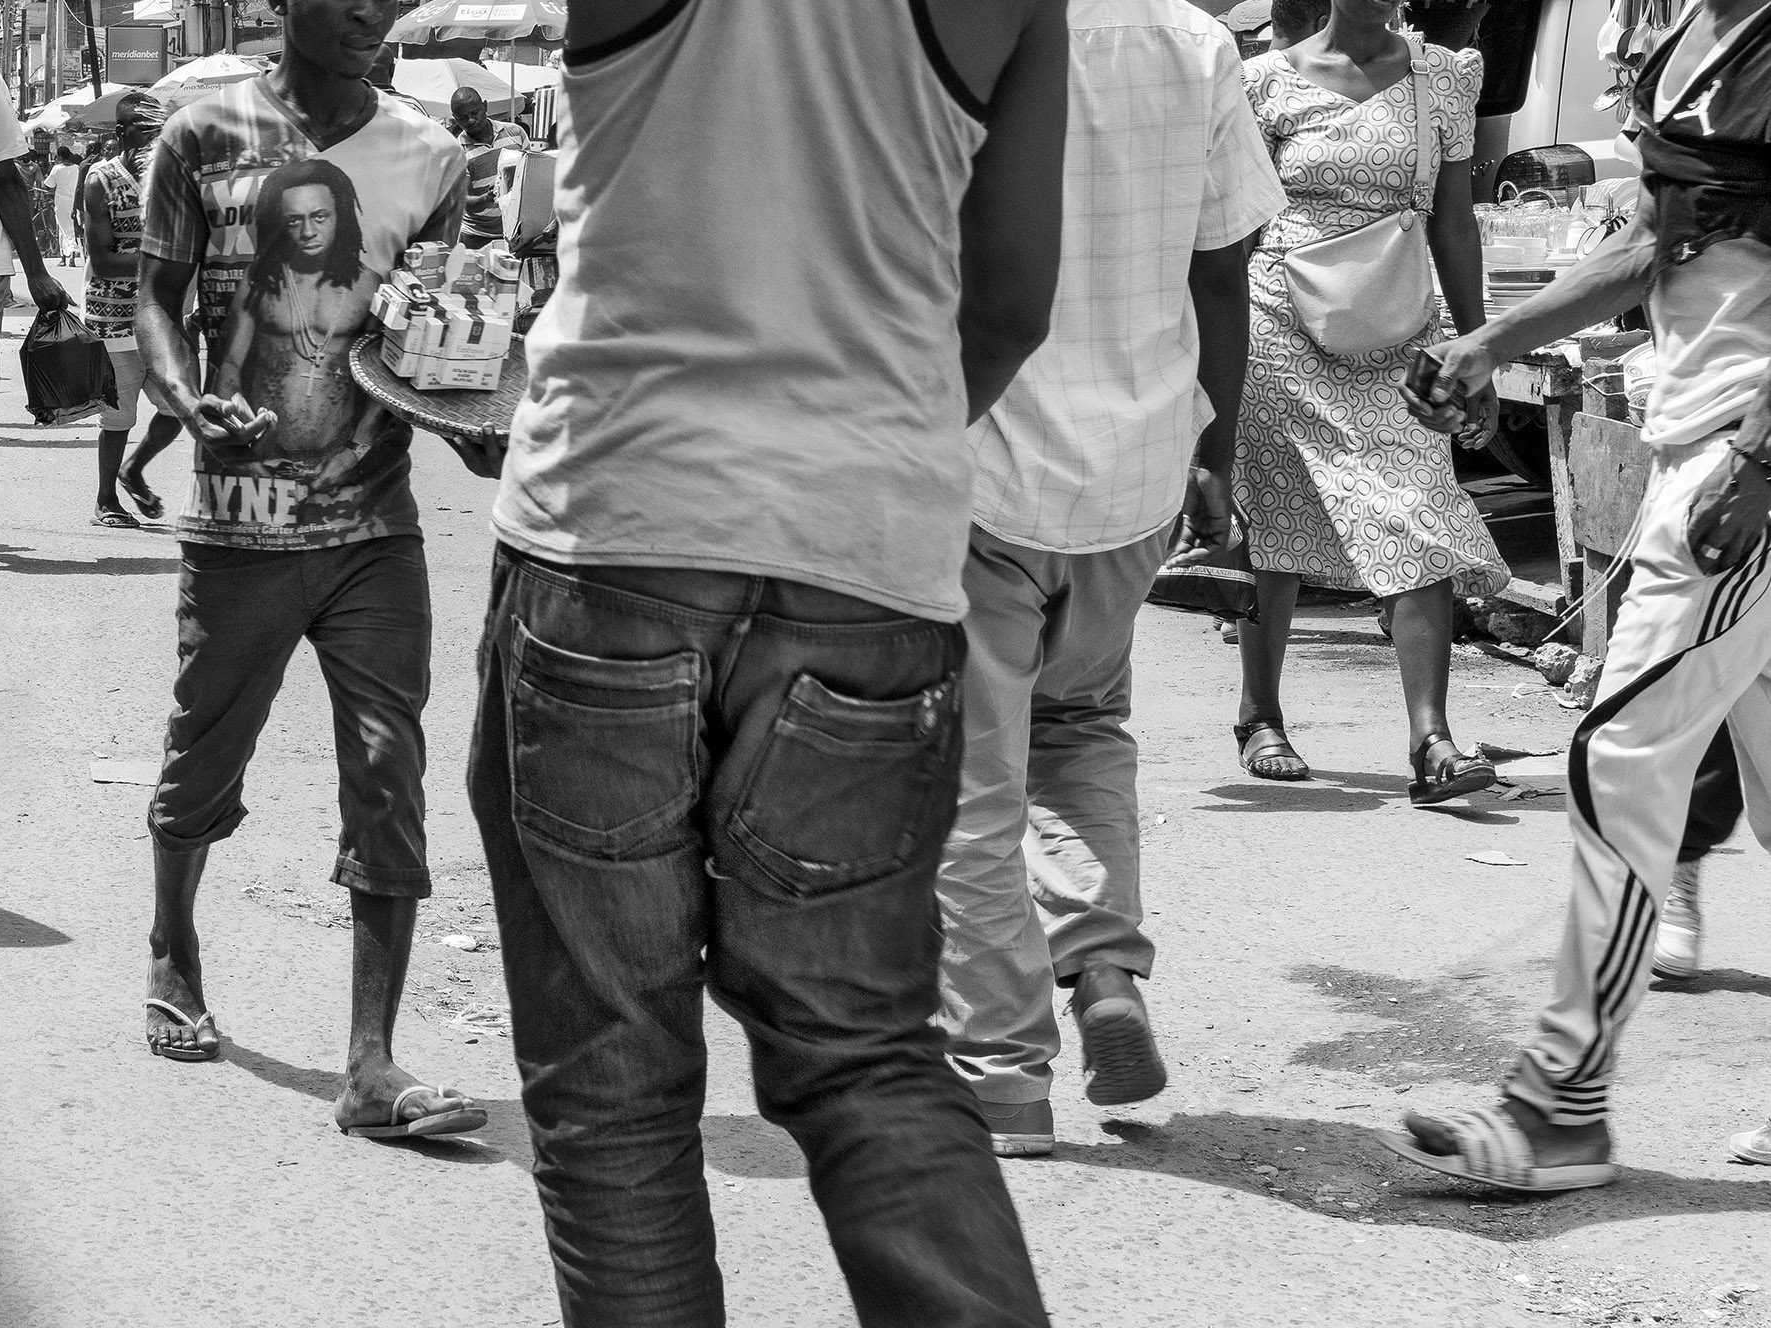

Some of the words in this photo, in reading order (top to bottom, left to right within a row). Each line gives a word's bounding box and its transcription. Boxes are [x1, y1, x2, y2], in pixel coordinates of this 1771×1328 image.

[411, 0, 456, 22] tigo
[460, 8, 487, 17] tigo
[112, 50, 159, 59] meridianbet
[261, 525, 294, 534] Carter
[285, 535, 306, 543] and
